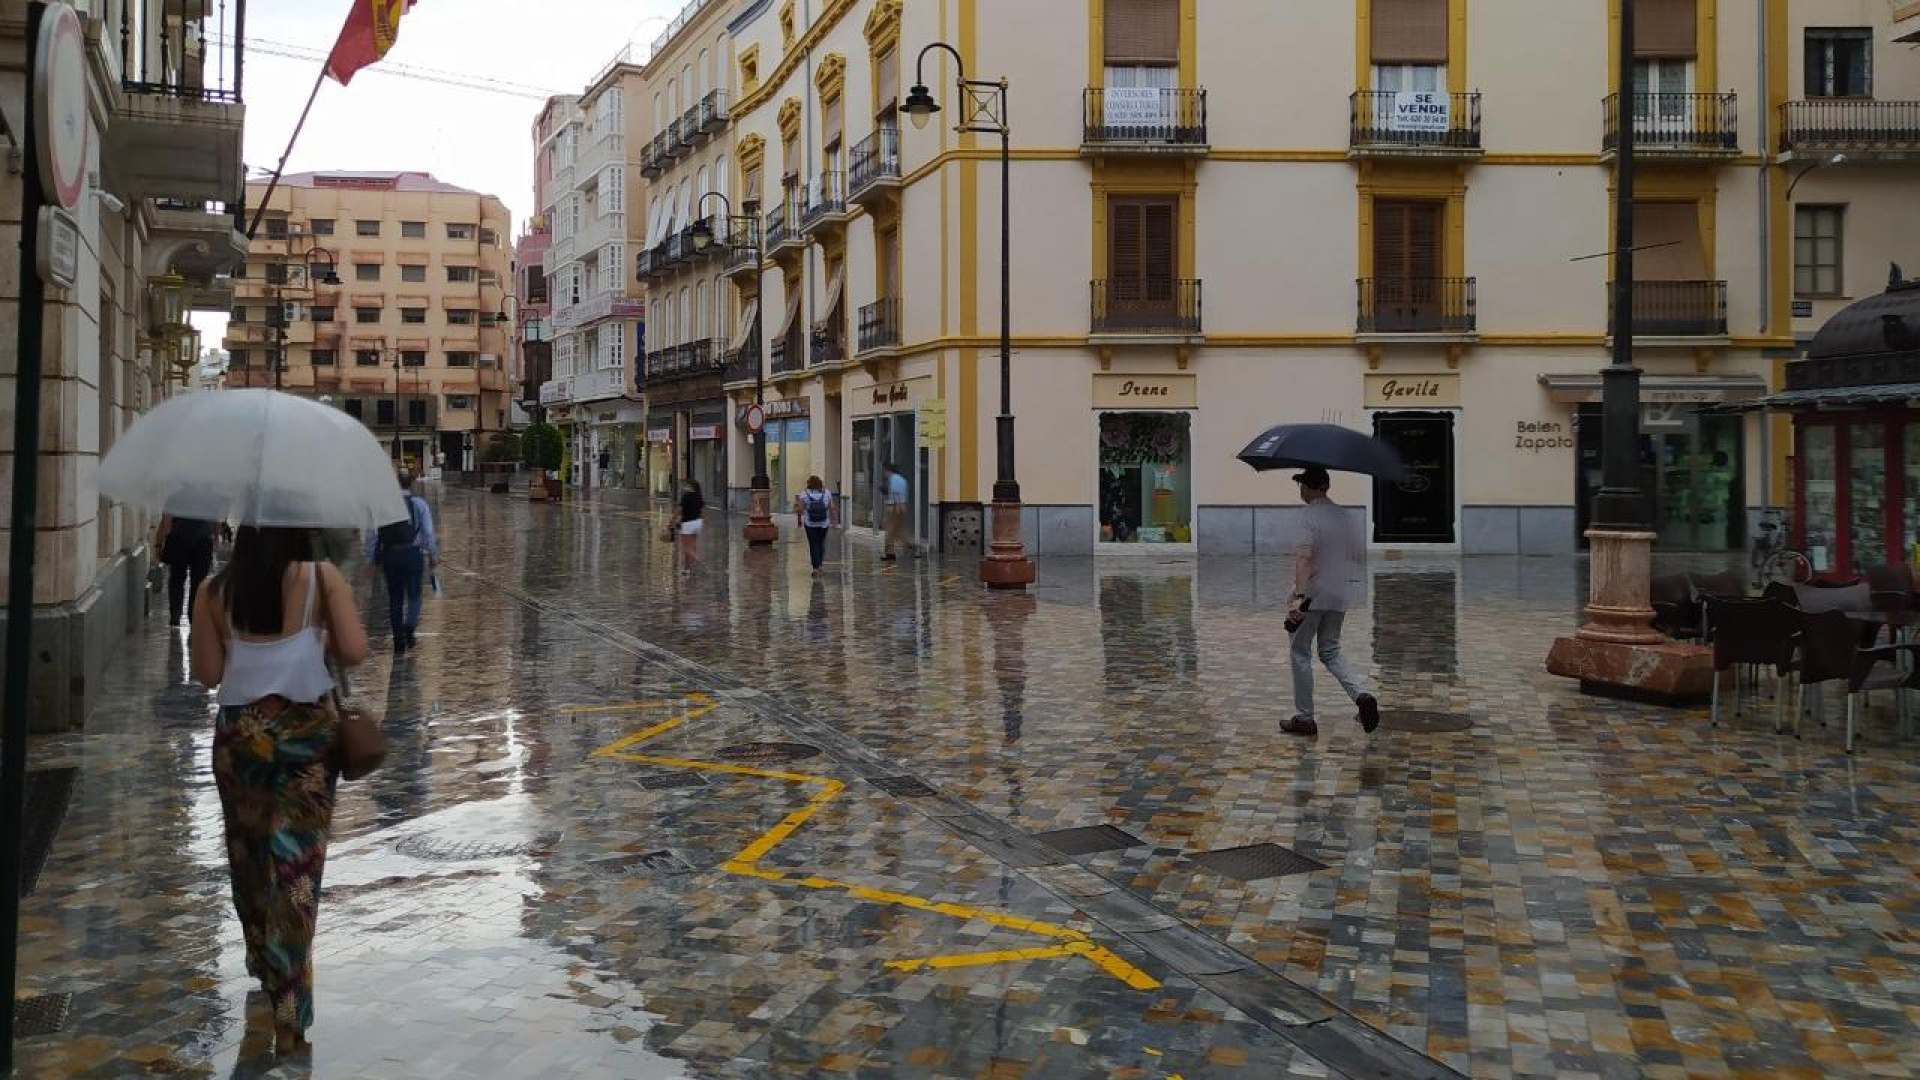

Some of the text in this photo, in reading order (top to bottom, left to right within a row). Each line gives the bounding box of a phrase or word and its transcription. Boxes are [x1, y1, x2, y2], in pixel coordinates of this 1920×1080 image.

[1415, 93, 1433, 103] SE
[1398, 104, 1447, 114] VENDE
[1118, 380, 1168, 397] Irene
[1514, 436, 1573, 453] Zapata
